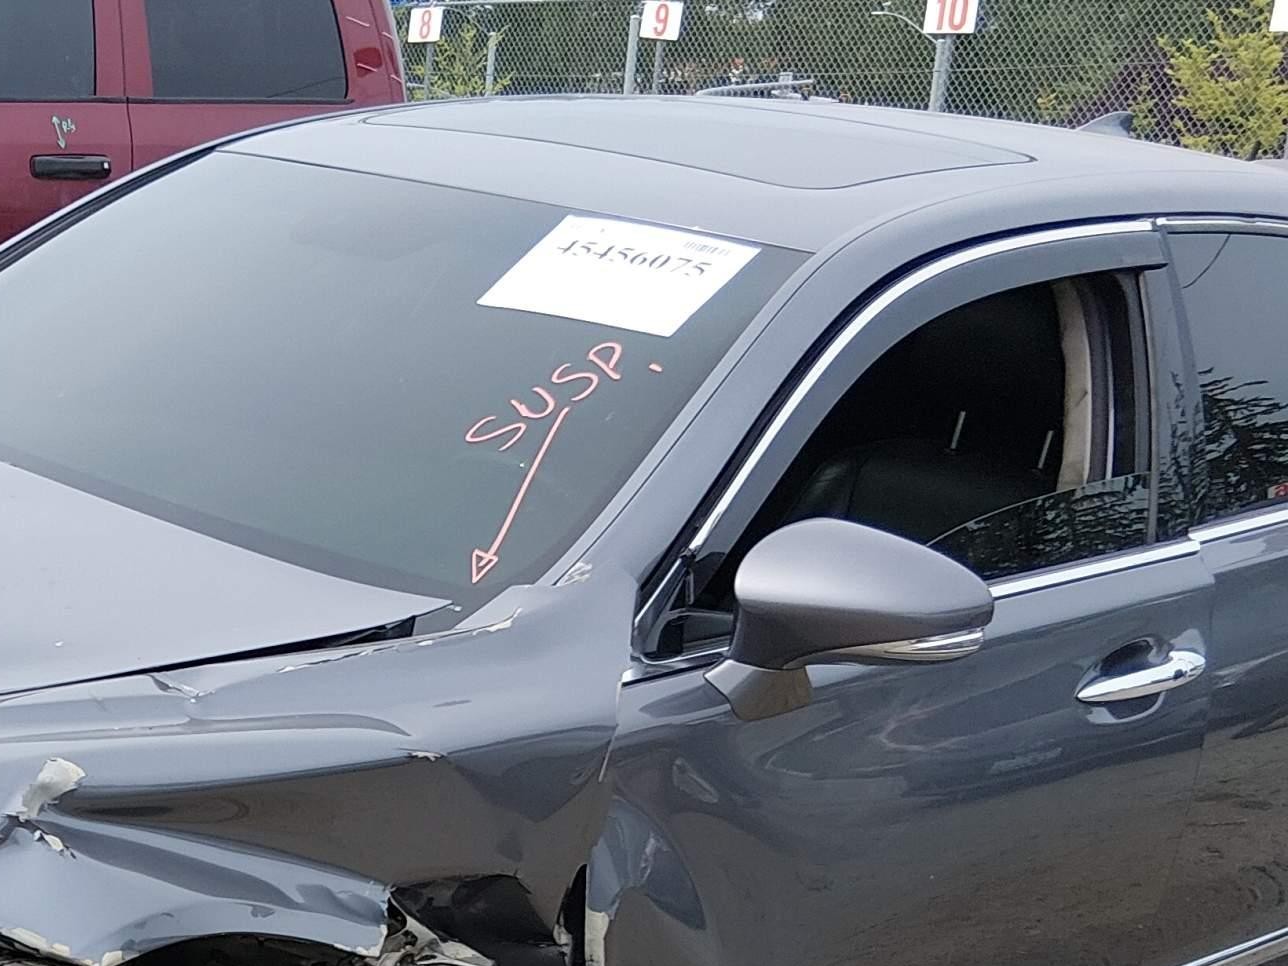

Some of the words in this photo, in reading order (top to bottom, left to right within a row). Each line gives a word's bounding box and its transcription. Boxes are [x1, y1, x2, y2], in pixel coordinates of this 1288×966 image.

[419, 9, 432, 39] 8
[652, 3, 670, 37] 9
[936, 0, 969, 31] 10
[557, 239, 712, 276] 45456075
